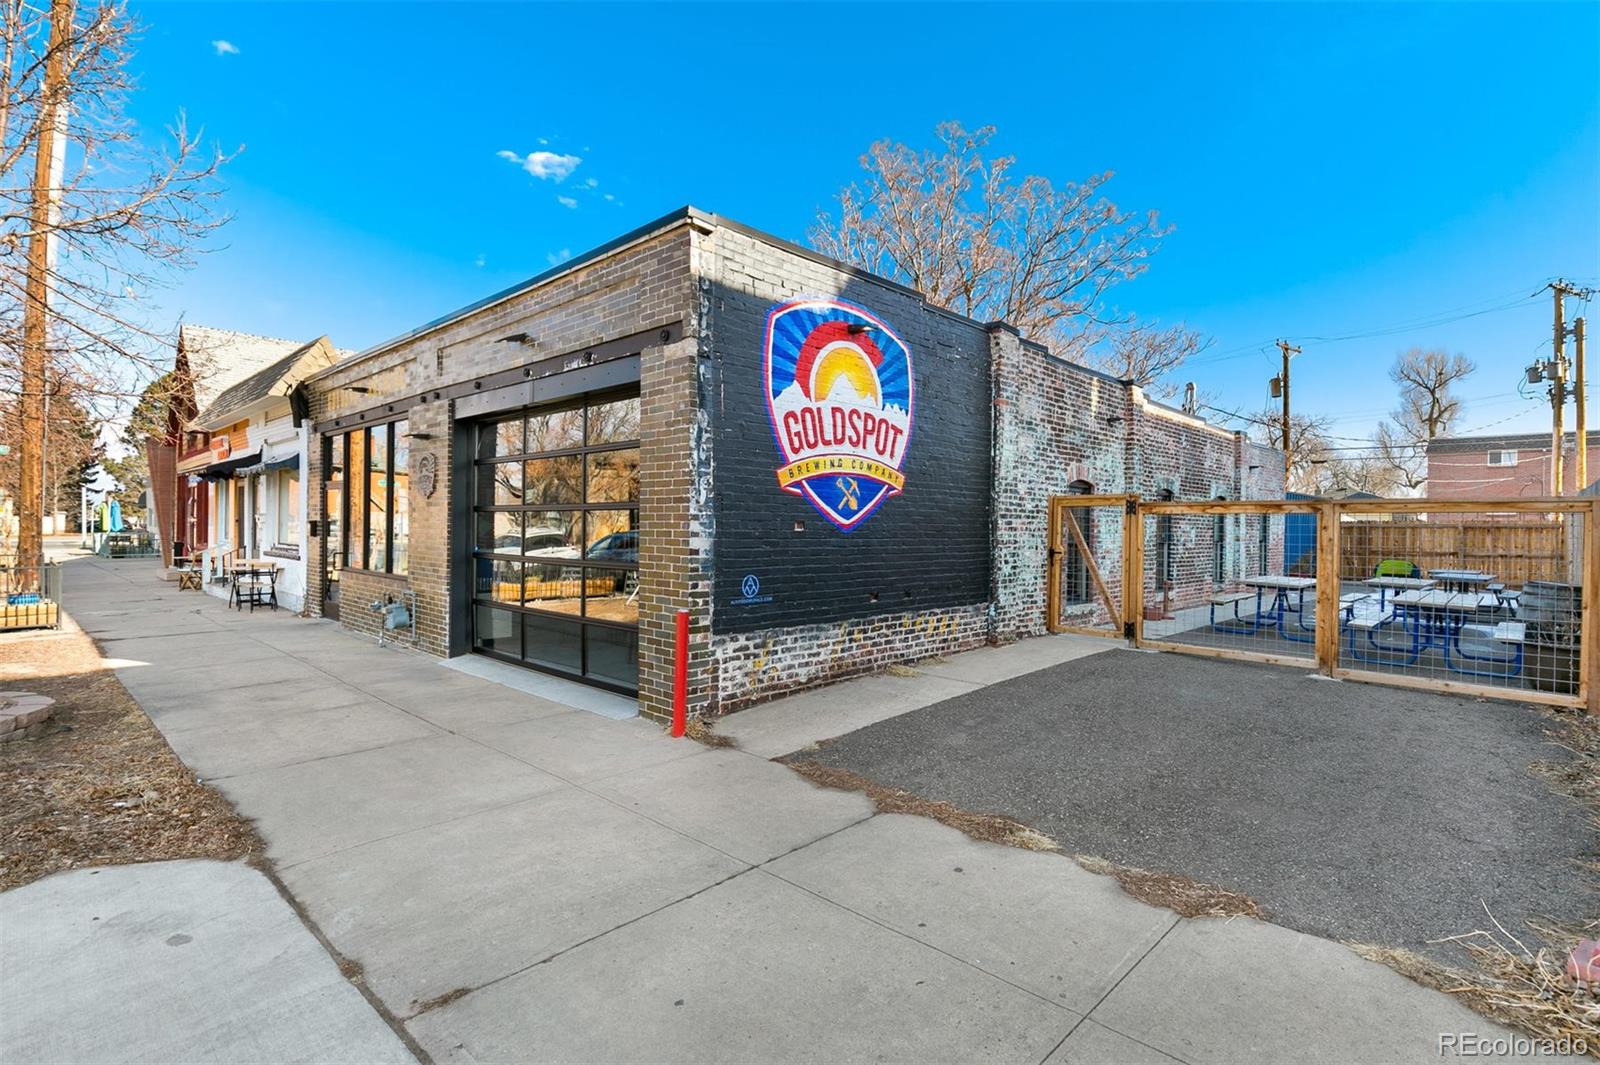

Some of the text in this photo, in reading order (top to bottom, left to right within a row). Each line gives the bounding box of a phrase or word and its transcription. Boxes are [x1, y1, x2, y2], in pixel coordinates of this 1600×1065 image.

[783, 406, 903, 459] GOLDSPOT
[788, 458, 899, 483] BREWING COMPANY
